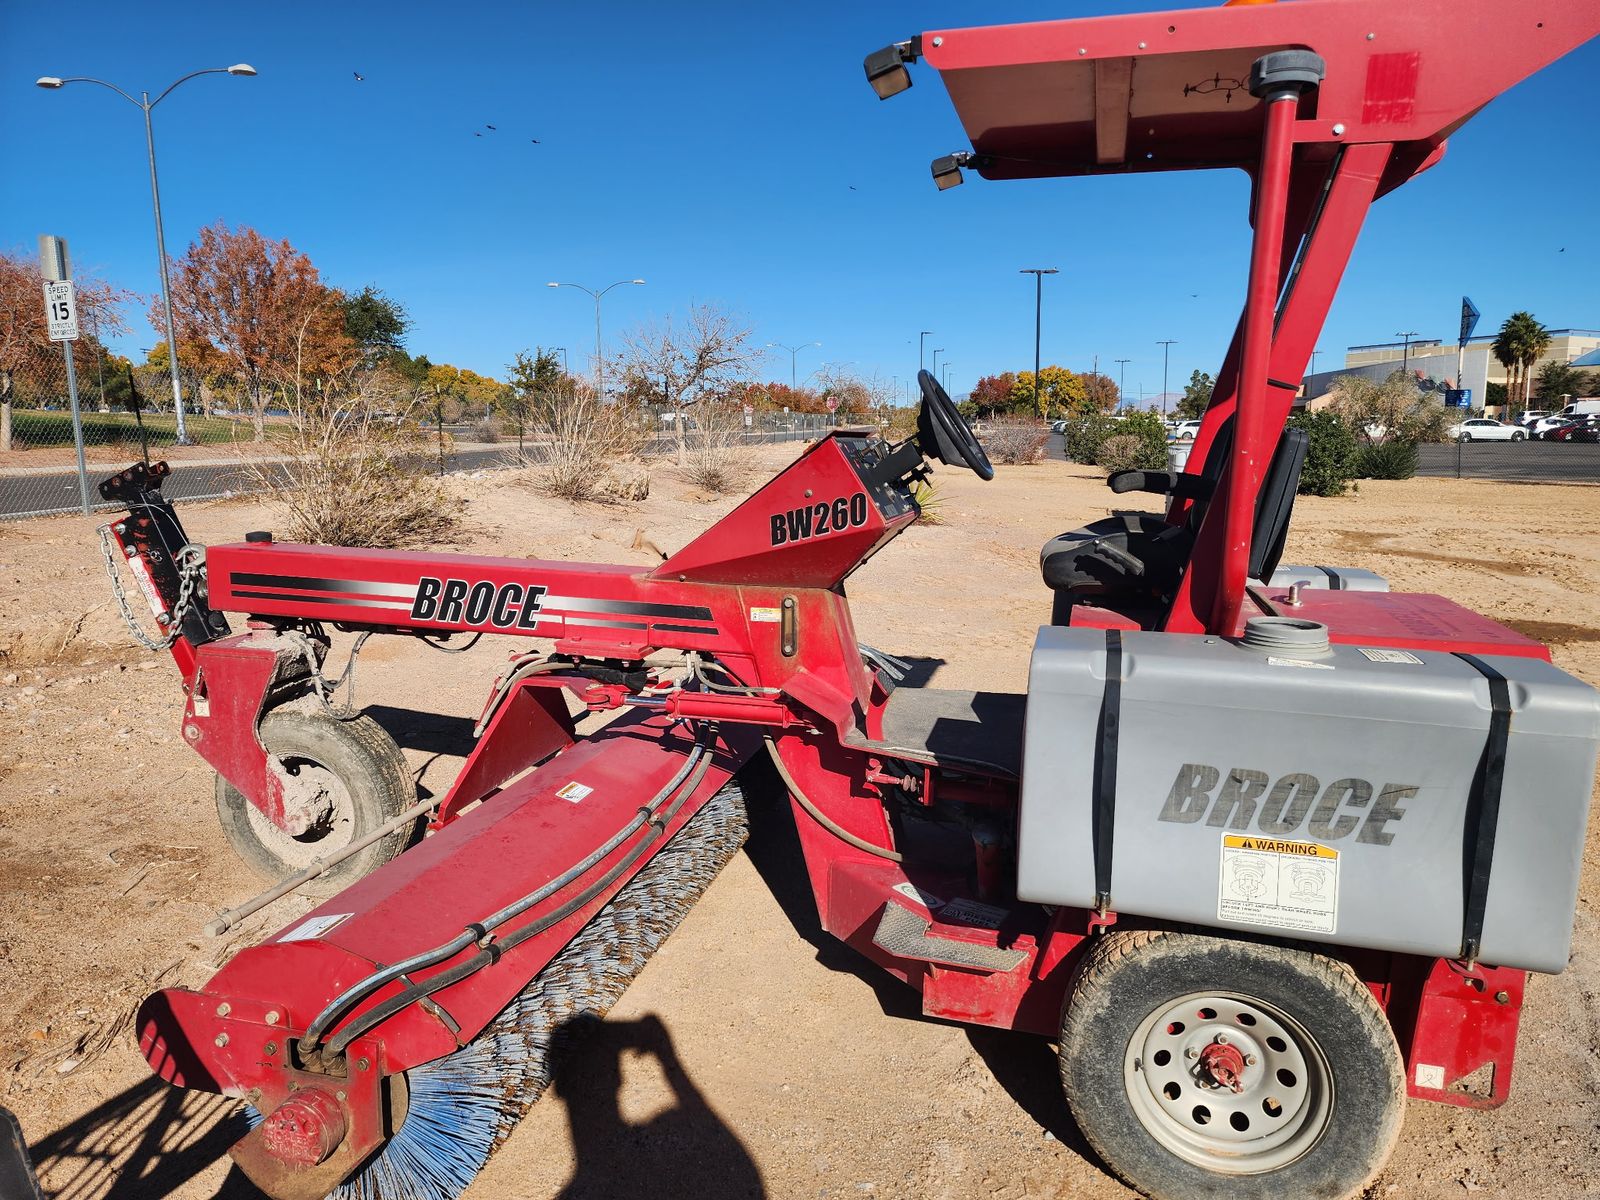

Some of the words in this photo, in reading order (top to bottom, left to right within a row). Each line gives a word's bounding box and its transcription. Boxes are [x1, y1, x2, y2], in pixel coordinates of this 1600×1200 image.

[48, 286, 68, 294] SPEED
[52, 302, 70, 320] 15
[770, 492, 868, 547] BW260
[410, 576, 548, 630] BROCE
[1157, 763, 1420, 847] BROCE
[1255, 840, 1318, 856] WARNING
